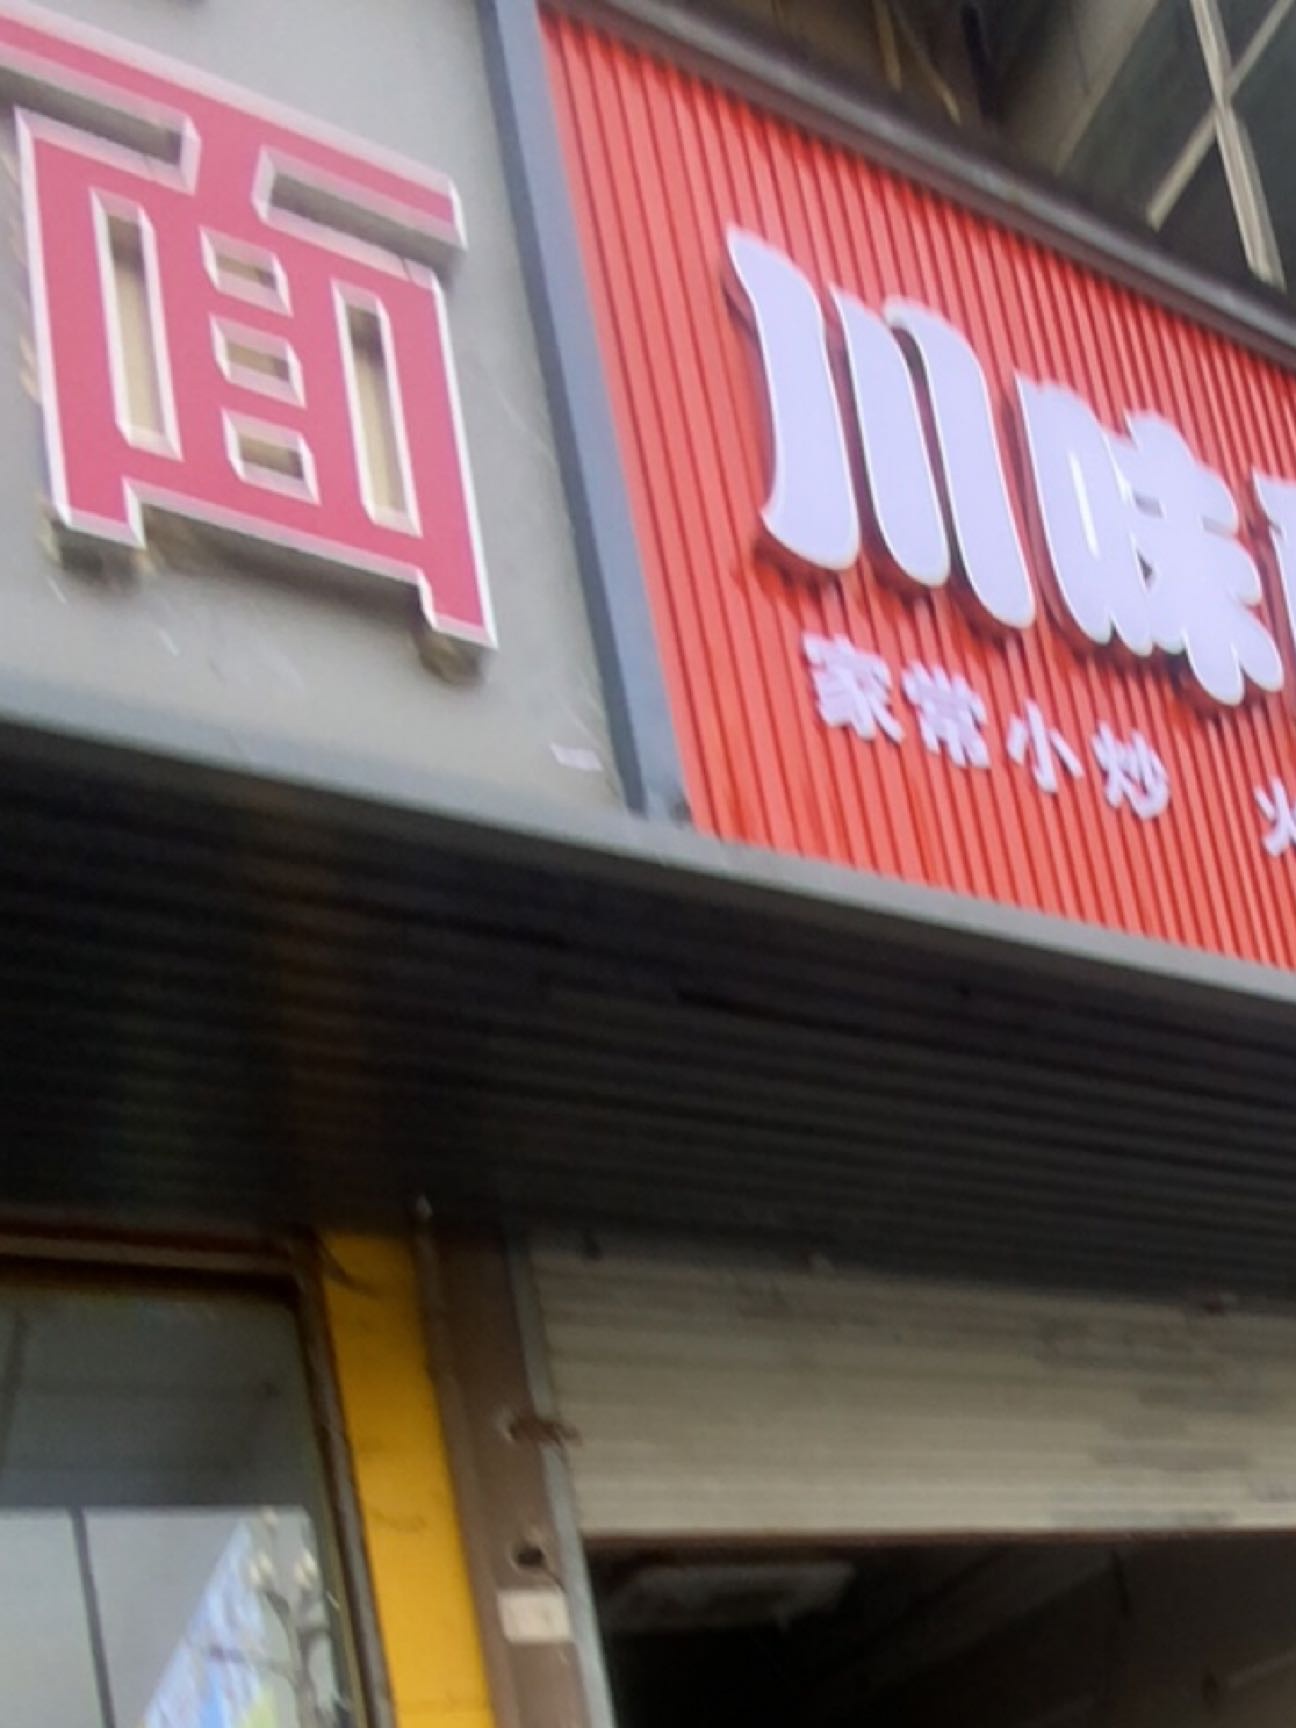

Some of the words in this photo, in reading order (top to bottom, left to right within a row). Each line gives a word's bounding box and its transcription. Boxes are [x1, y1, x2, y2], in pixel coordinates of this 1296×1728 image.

[0, 12, 499, 649] 面
[803, 632, 1170, 821] 家常小炒
